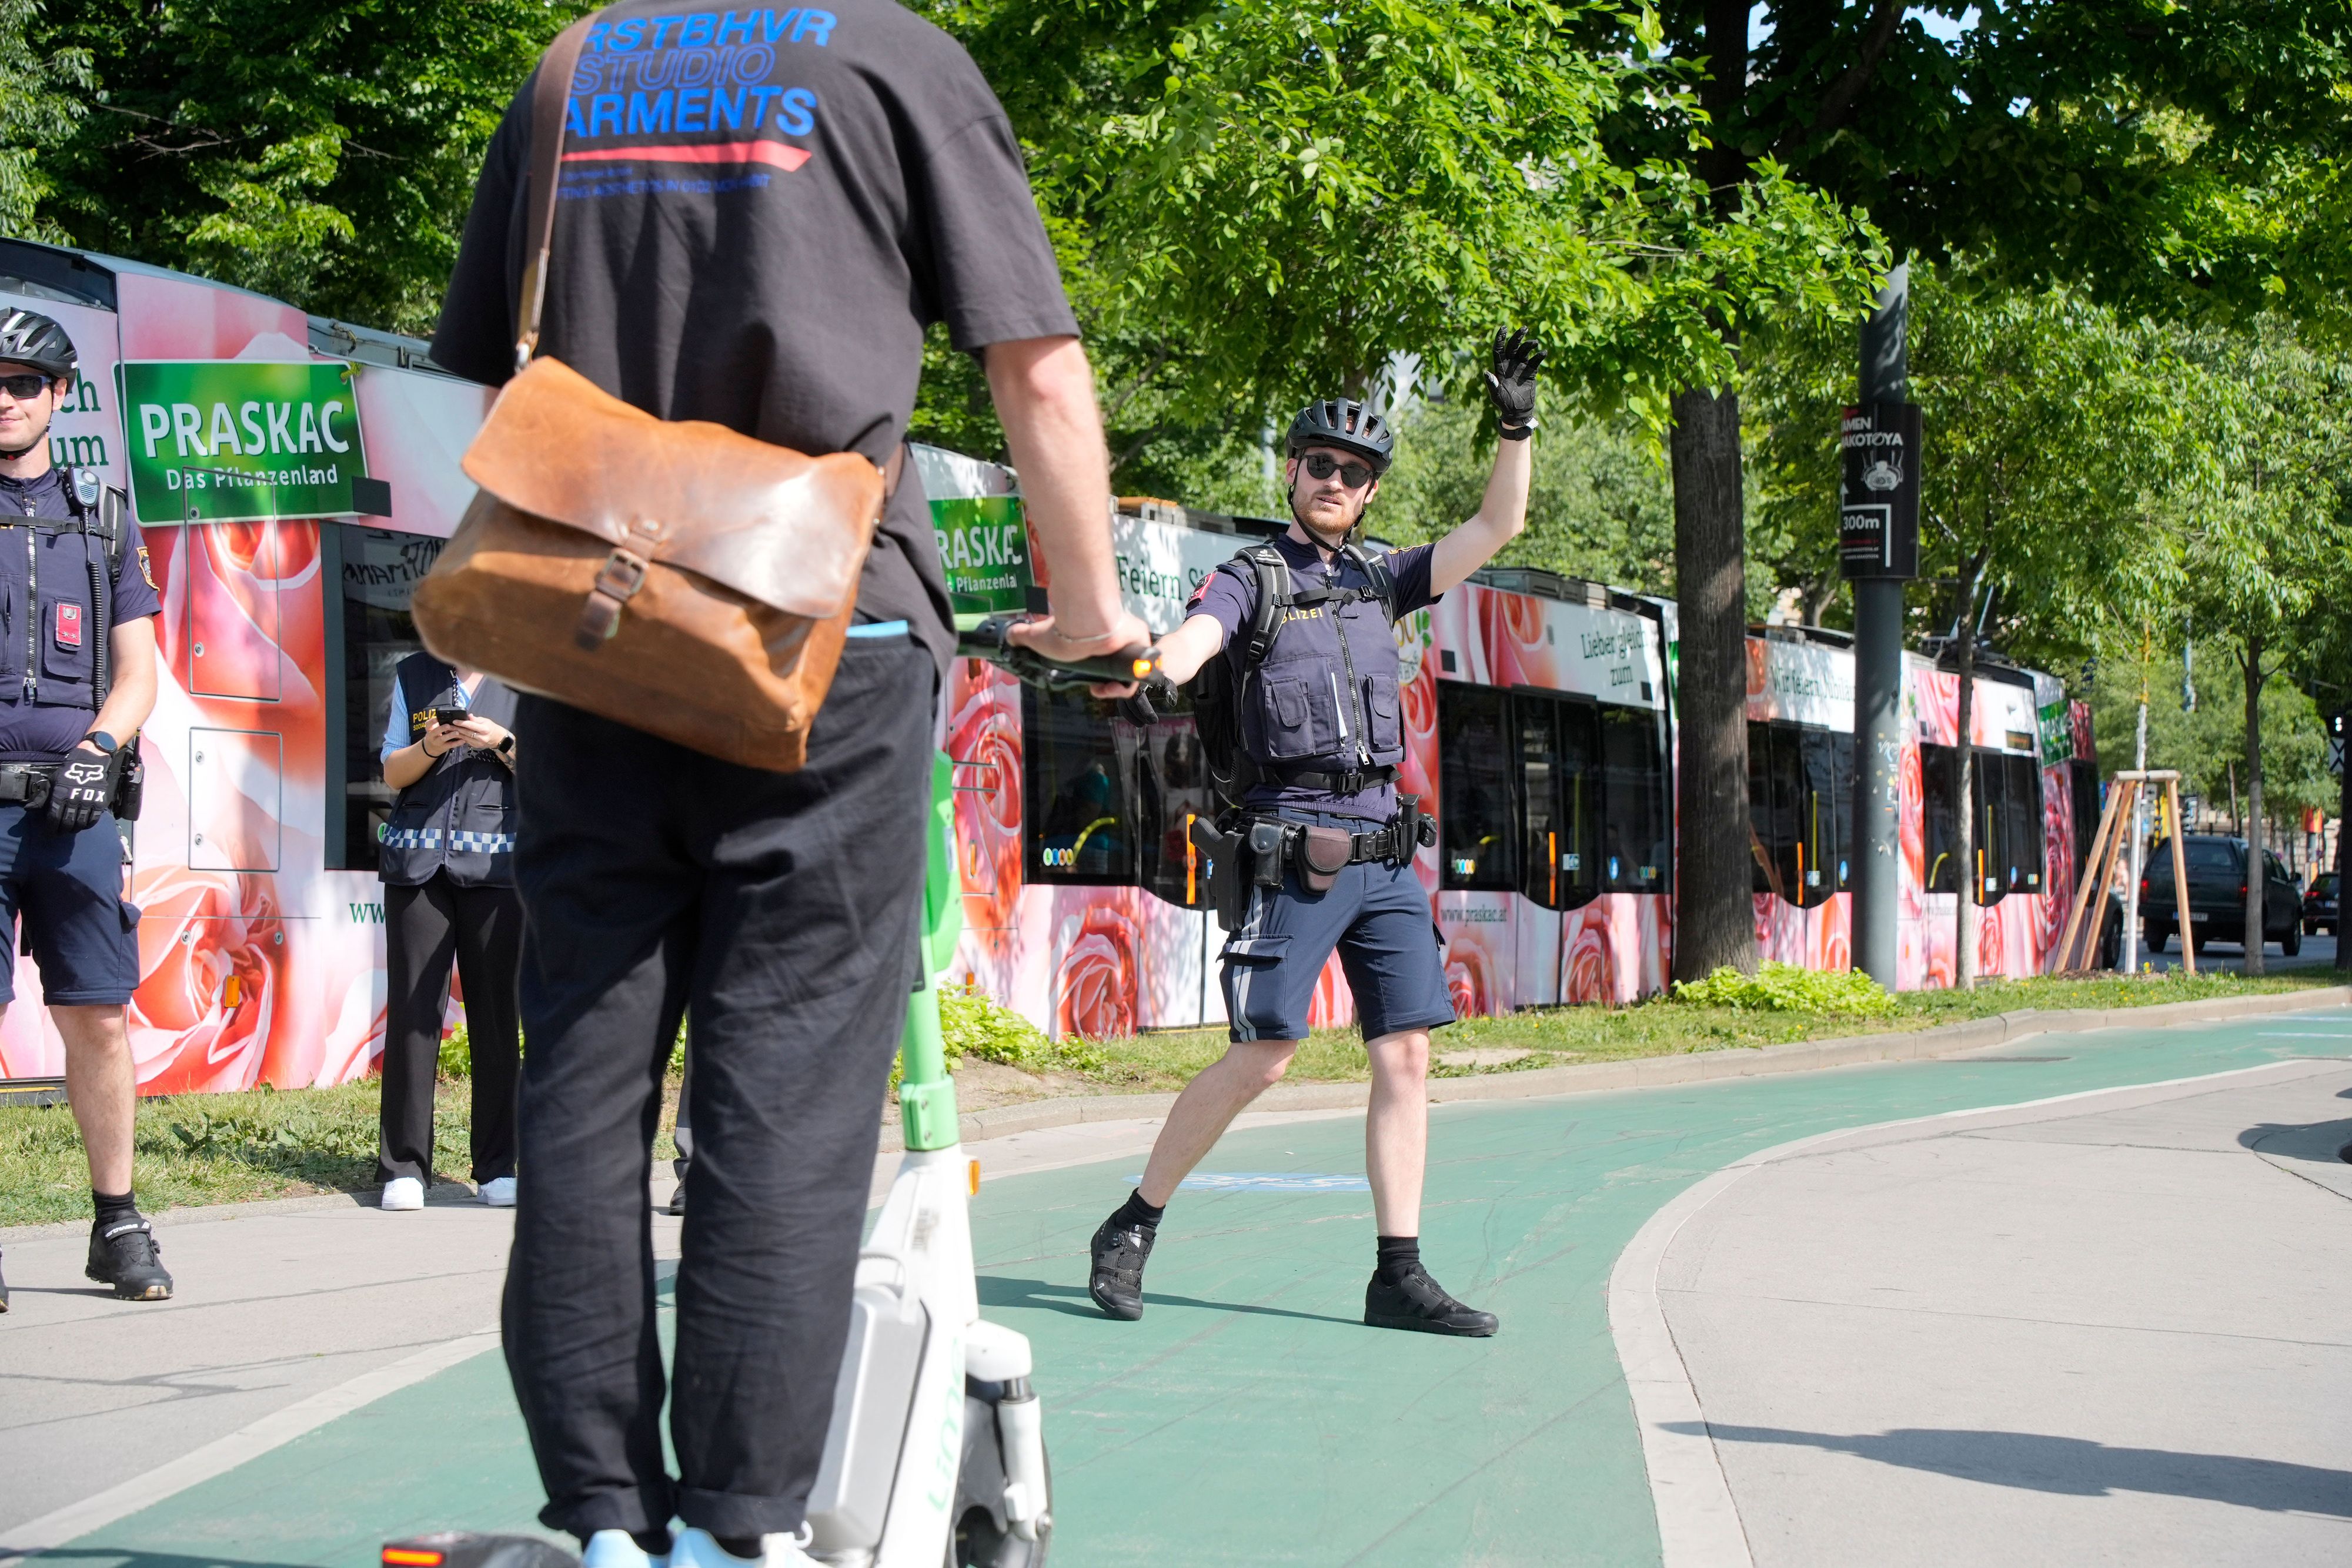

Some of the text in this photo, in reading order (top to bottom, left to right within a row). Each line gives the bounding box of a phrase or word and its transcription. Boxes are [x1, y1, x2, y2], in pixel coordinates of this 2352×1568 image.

[571, 43, 776, 95] STUDIO
[566, 85, 817, 137] ARMENTS
[139, 400, 350, 458] PRASKAC
[166, 463, 339, 490] Das Pflanzenland
[1843, 514, 1879, 531] 300m
[1115, 556, 1182, 600] Feiern
[1581, 631, 1615, 658] Lieber
[1610, 666, 1633, 686] zum
[70, 788, 105, 803] FOX
